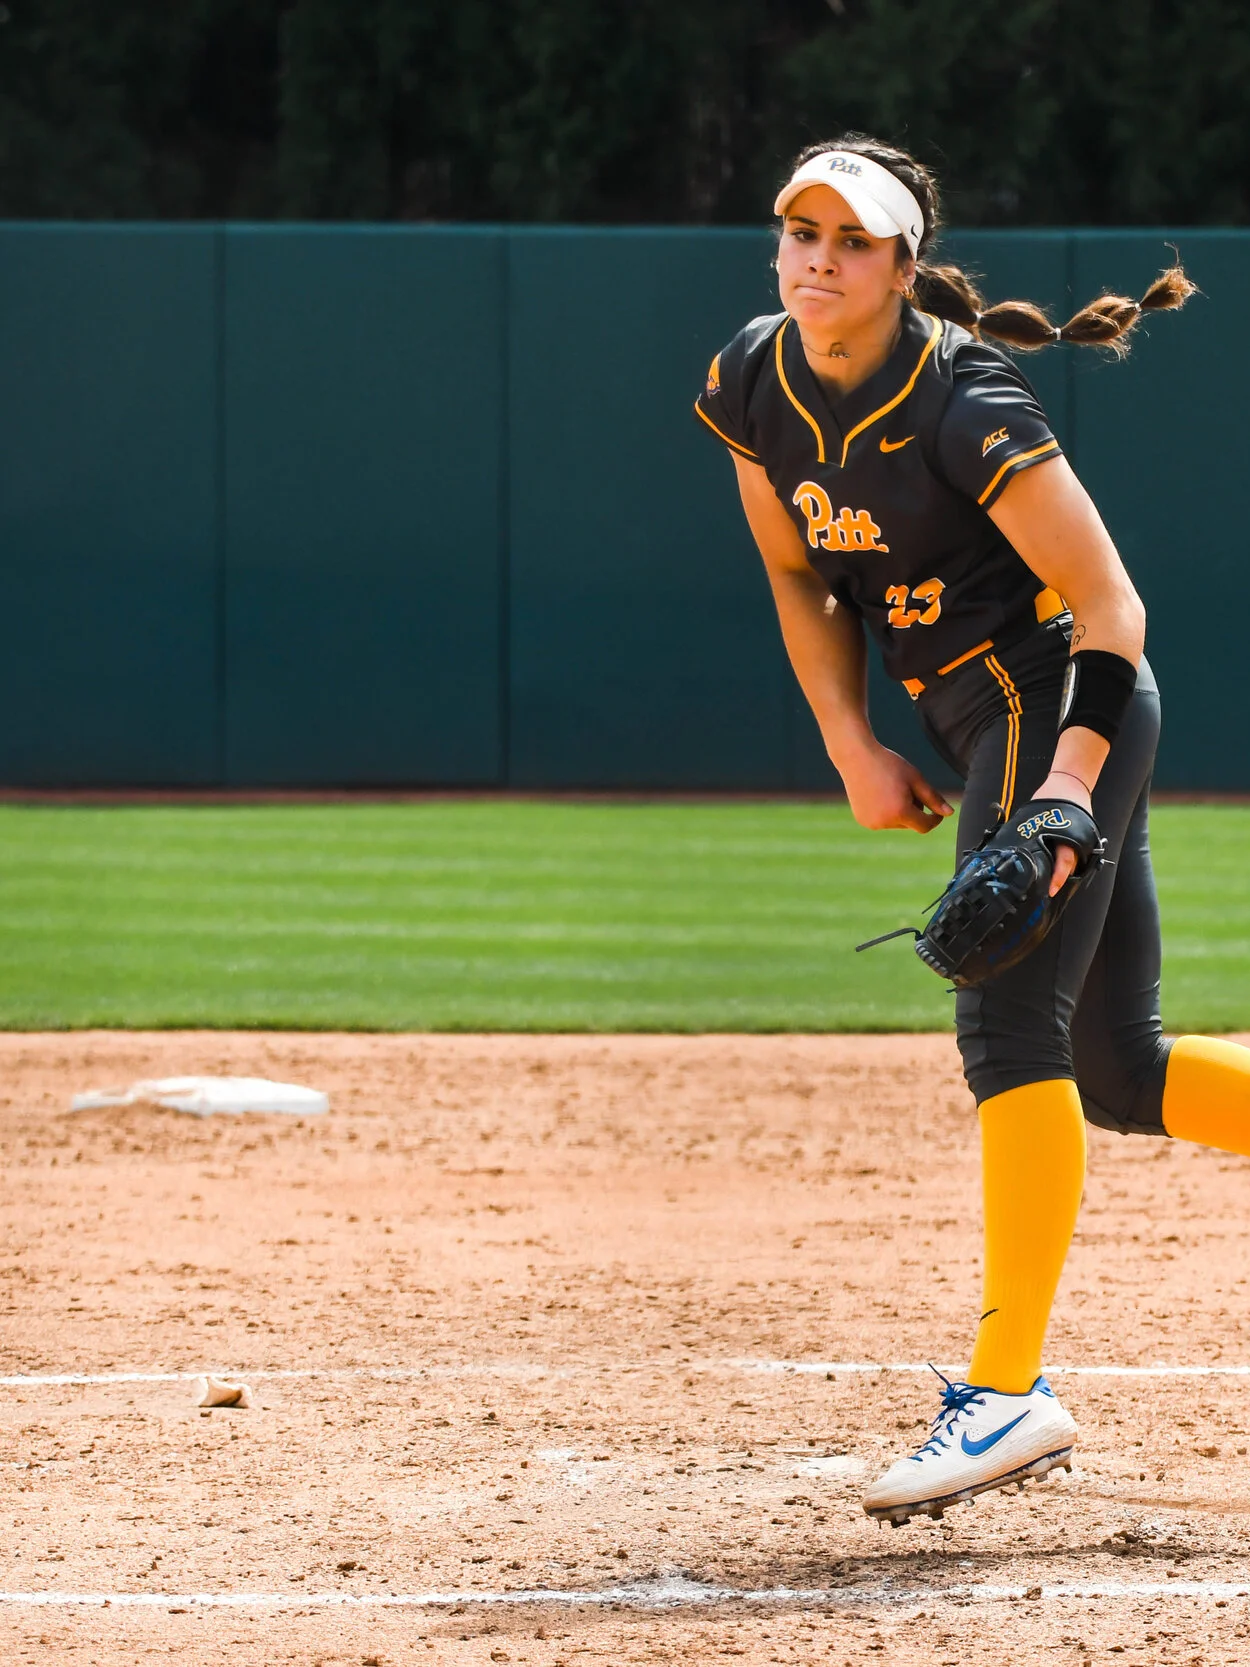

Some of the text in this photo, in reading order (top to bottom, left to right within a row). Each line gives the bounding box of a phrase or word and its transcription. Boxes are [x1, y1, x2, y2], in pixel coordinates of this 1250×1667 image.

[827, 157, 863, 177] Pitt
[982, 426, 1010, 454] ACC
[792, 481, 889, 553] Pitt
[885, 577, 946, 628] 23
[1018, 808, 1072, 839] Pitt
